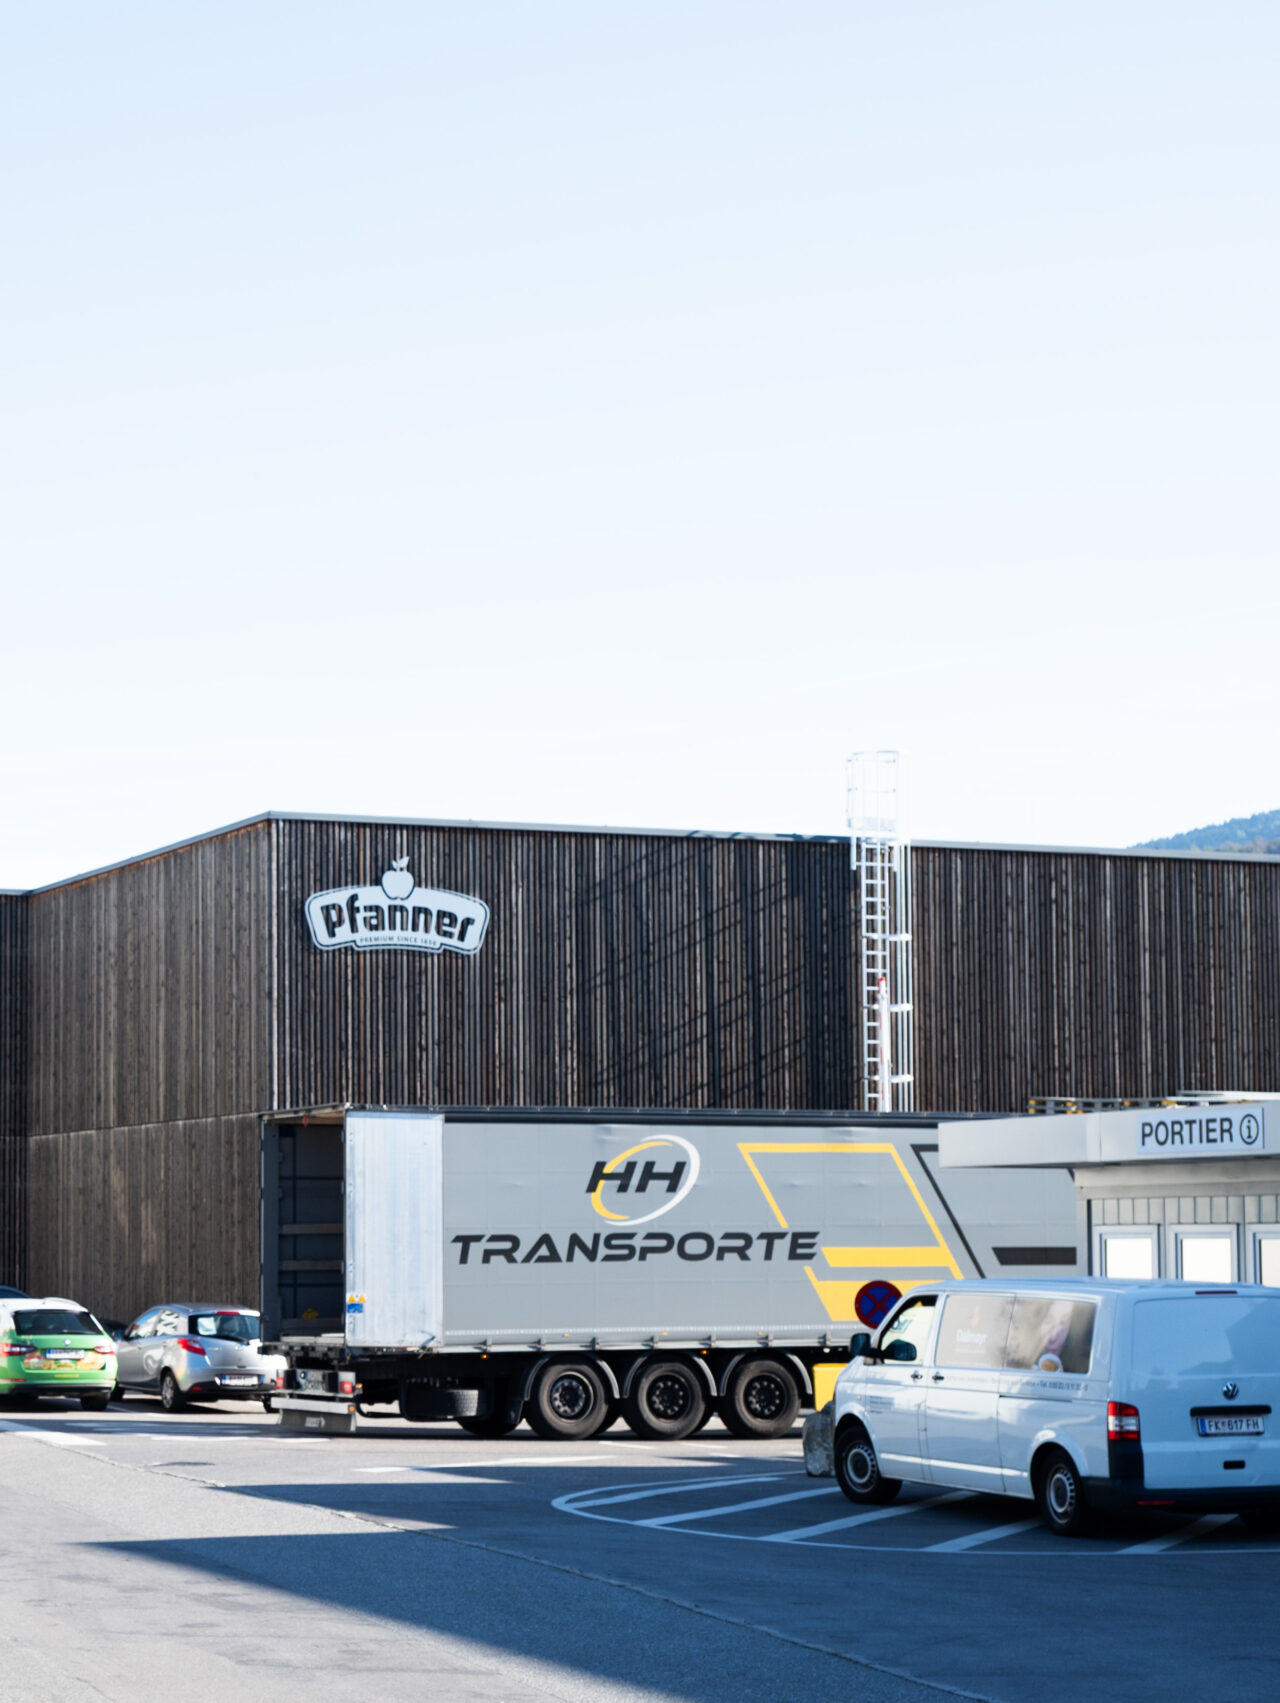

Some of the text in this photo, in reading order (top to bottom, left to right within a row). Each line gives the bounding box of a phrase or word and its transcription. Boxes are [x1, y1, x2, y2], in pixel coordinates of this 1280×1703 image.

[321, 893, 475, 942] pfanner
[359, 935, 394, 944] PREMIUM
[397, 935, 418, 944] SINCE
[1141, 1117, 1234, 1147] PORTIER
[585, 1160, 688, 1194] HH
[451, 1231, 820, 1265] TRANSPORTE
